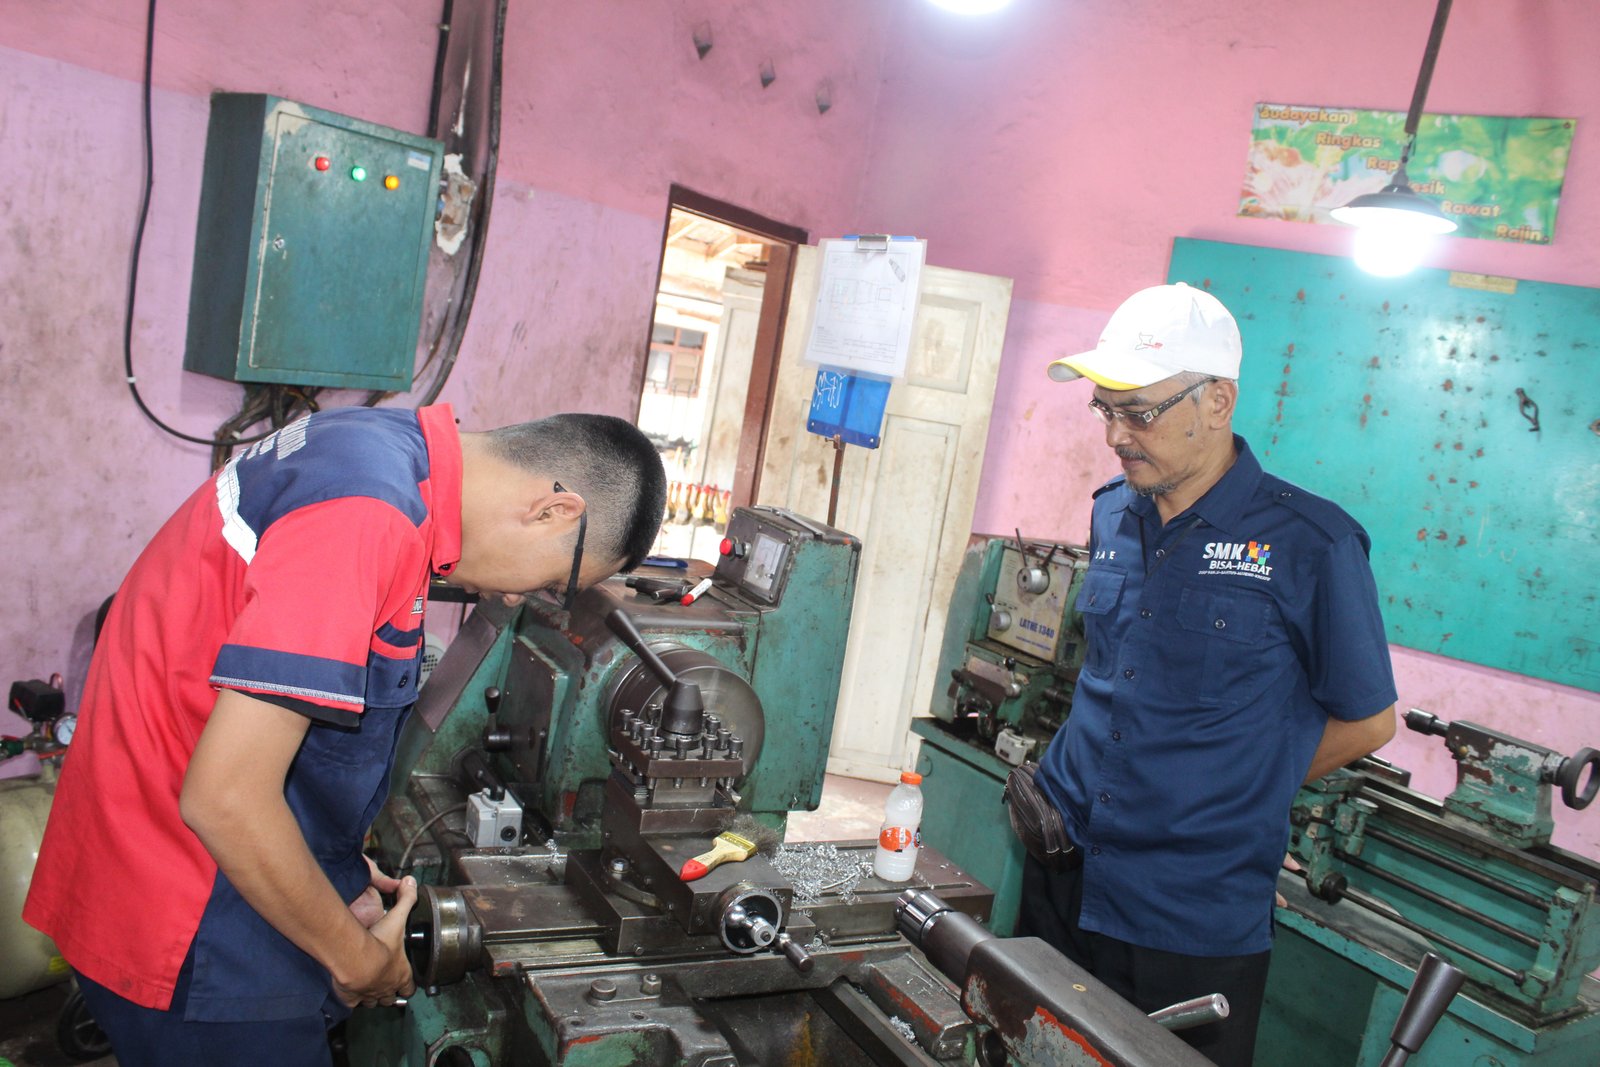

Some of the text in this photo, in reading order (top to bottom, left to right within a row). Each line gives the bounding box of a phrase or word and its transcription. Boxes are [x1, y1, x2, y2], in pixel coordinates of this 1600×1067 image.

[1316, 131, 1381, 150] Ringkas
[1366, 155, 1403, 174] Rap
[1407, 179, 1446, 195] esik
[1440, 200, 1501, 217] Rawat
[1202, 542, 1246, 560] SMK
[1209, 560, 1273, 576] BISA-HEBAT
[1019, 616, 1055, 639] LATHE 1340
